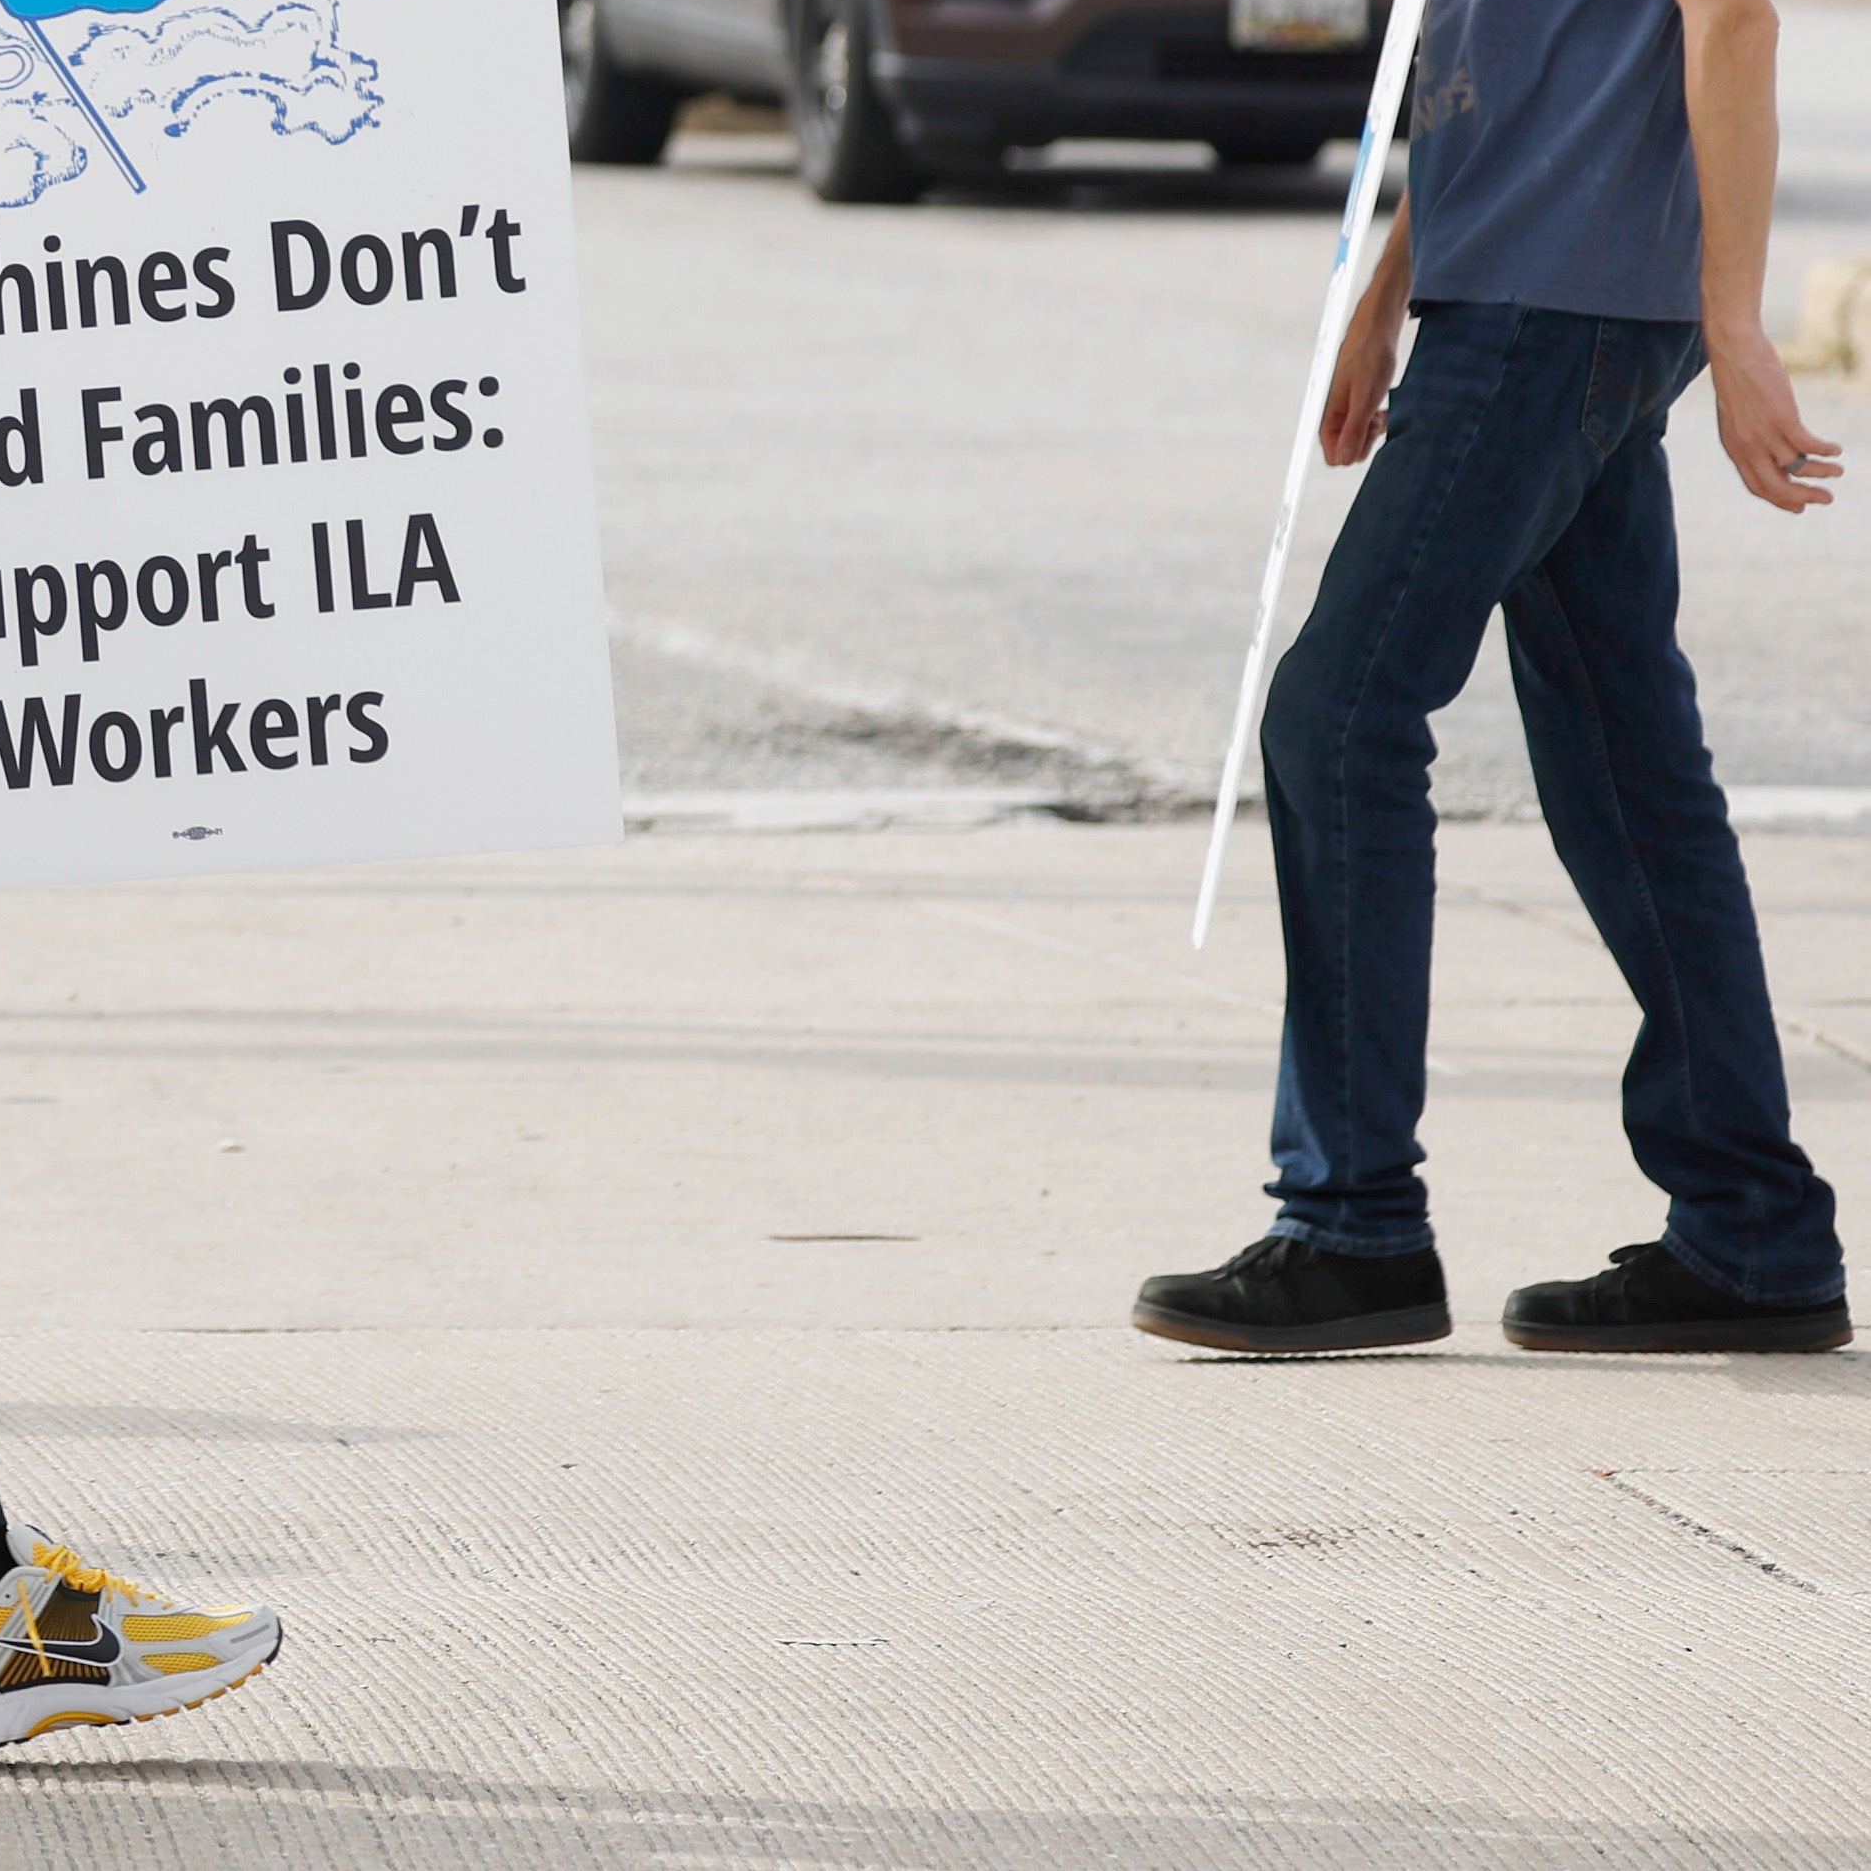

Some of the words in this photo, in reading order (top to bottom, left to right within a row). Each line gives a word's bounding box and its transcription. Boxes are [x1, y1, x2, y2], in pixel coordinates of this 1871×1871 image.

[271, 204, 527, 312] Don’t
[82, 362, 505, 480] Families:
[311, 512, 462, 614] ILA
